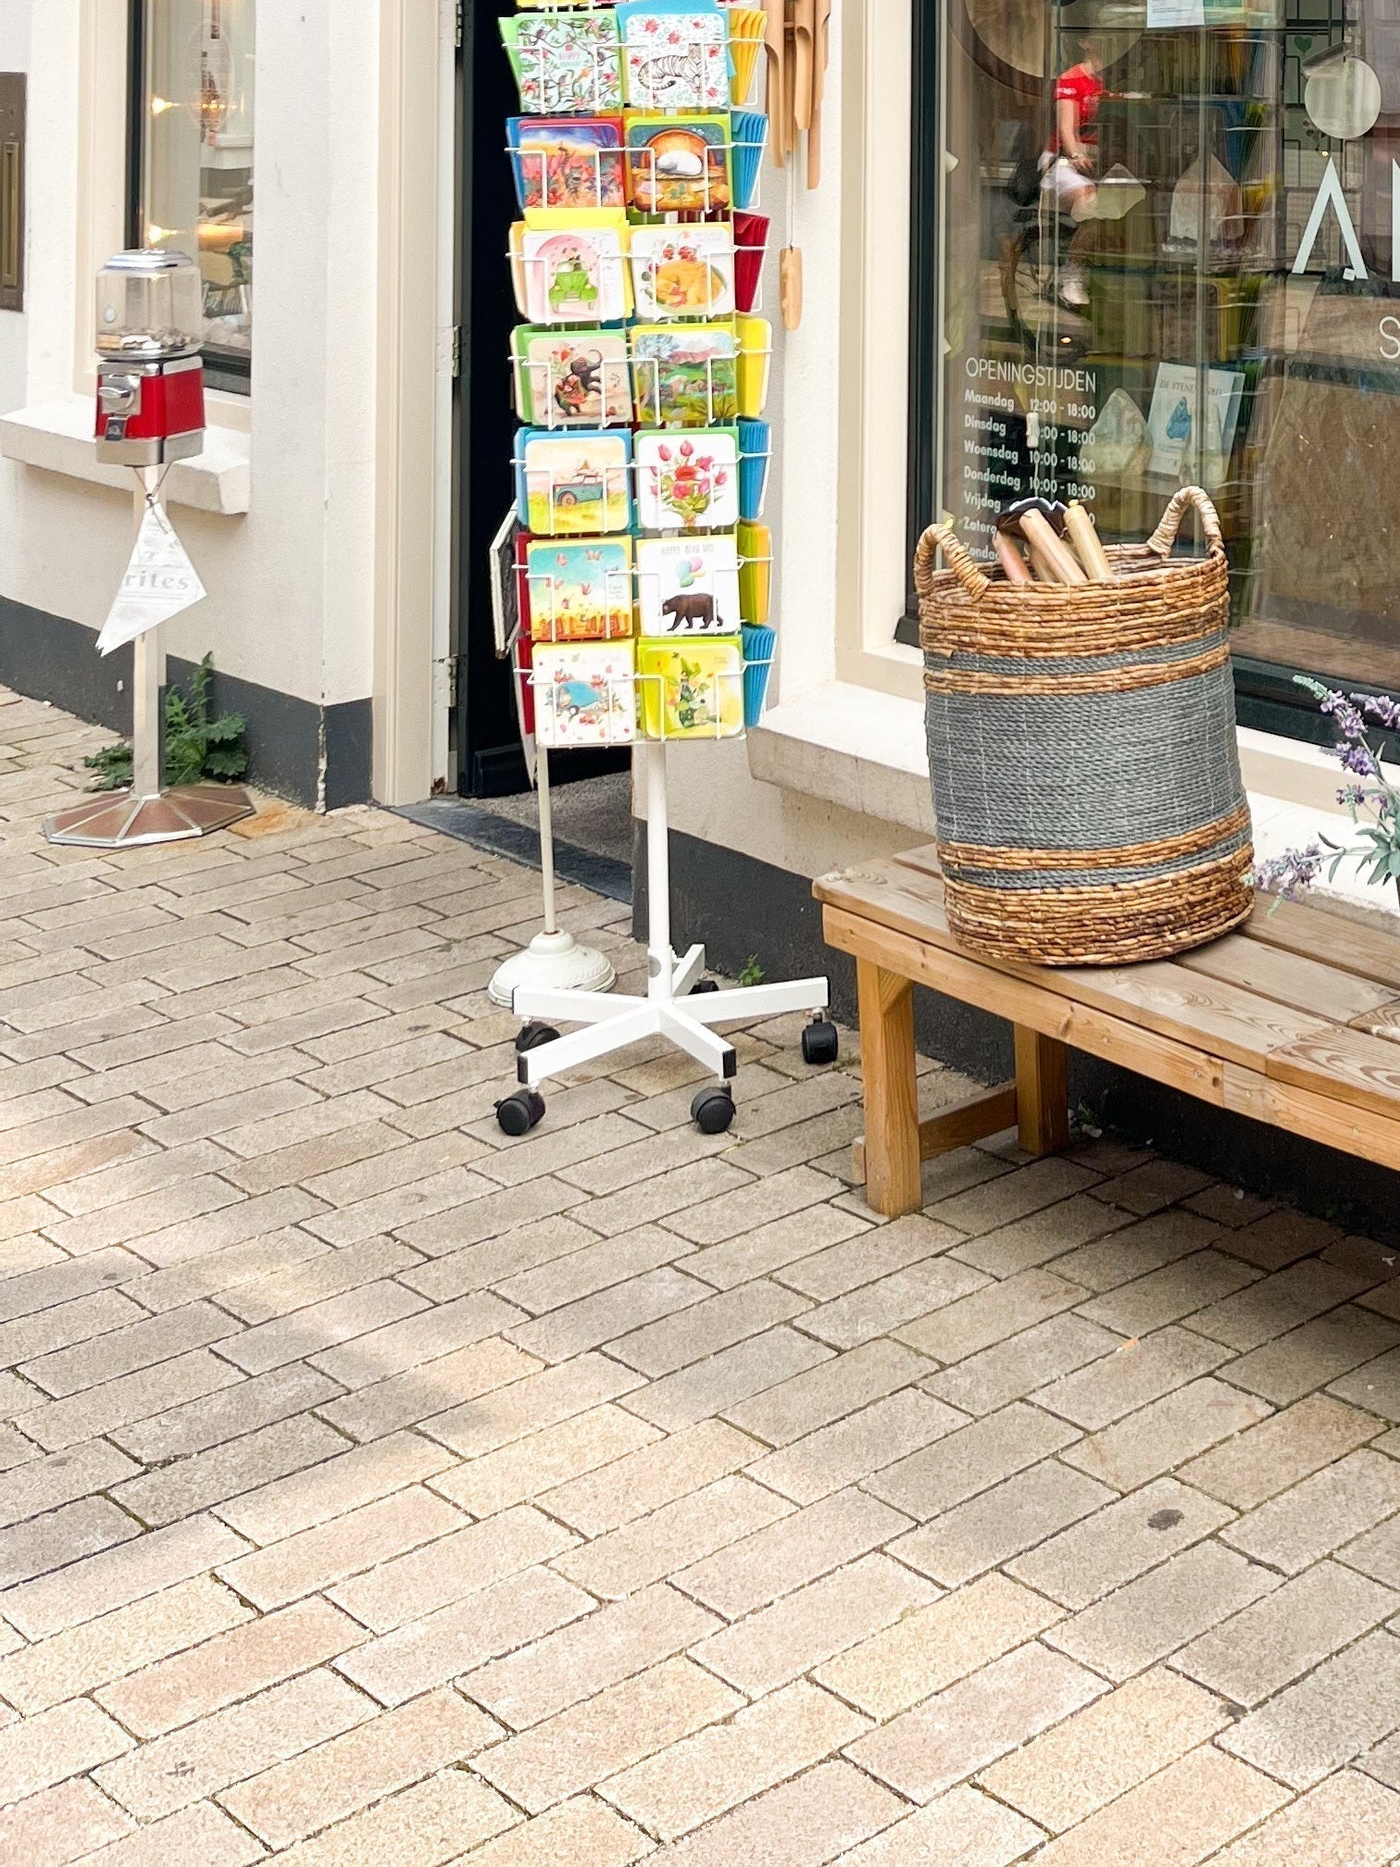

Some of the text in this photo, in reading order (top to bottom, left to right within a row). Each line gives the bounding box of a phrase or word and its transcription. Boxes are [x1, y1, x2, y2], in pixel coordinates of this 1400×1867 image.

[965, 356, 1097, 394] OPENINGSTIJDEN
[964, 389, 1015, 413] Maandag
[1029, 398, 1058, 415] 12:00
[1067, 403, 1097, 420] 18:00
[964, 414, 1007, 437] Dinsdag
[1067, 430, 1097, 446] 18:00
[964, 439, 1019, 465] Woensdag
[1029, 450, 1058, 467] 10:00
[1067, 456, 1096, 472] 18:00
[963, 465, 1021, 491] Donderdag
[1029, 477, 1058, 494] 10:00
[1067, 483, 1096, 500] 18:00
[963, 491, 1002, 512] Vrijdag
